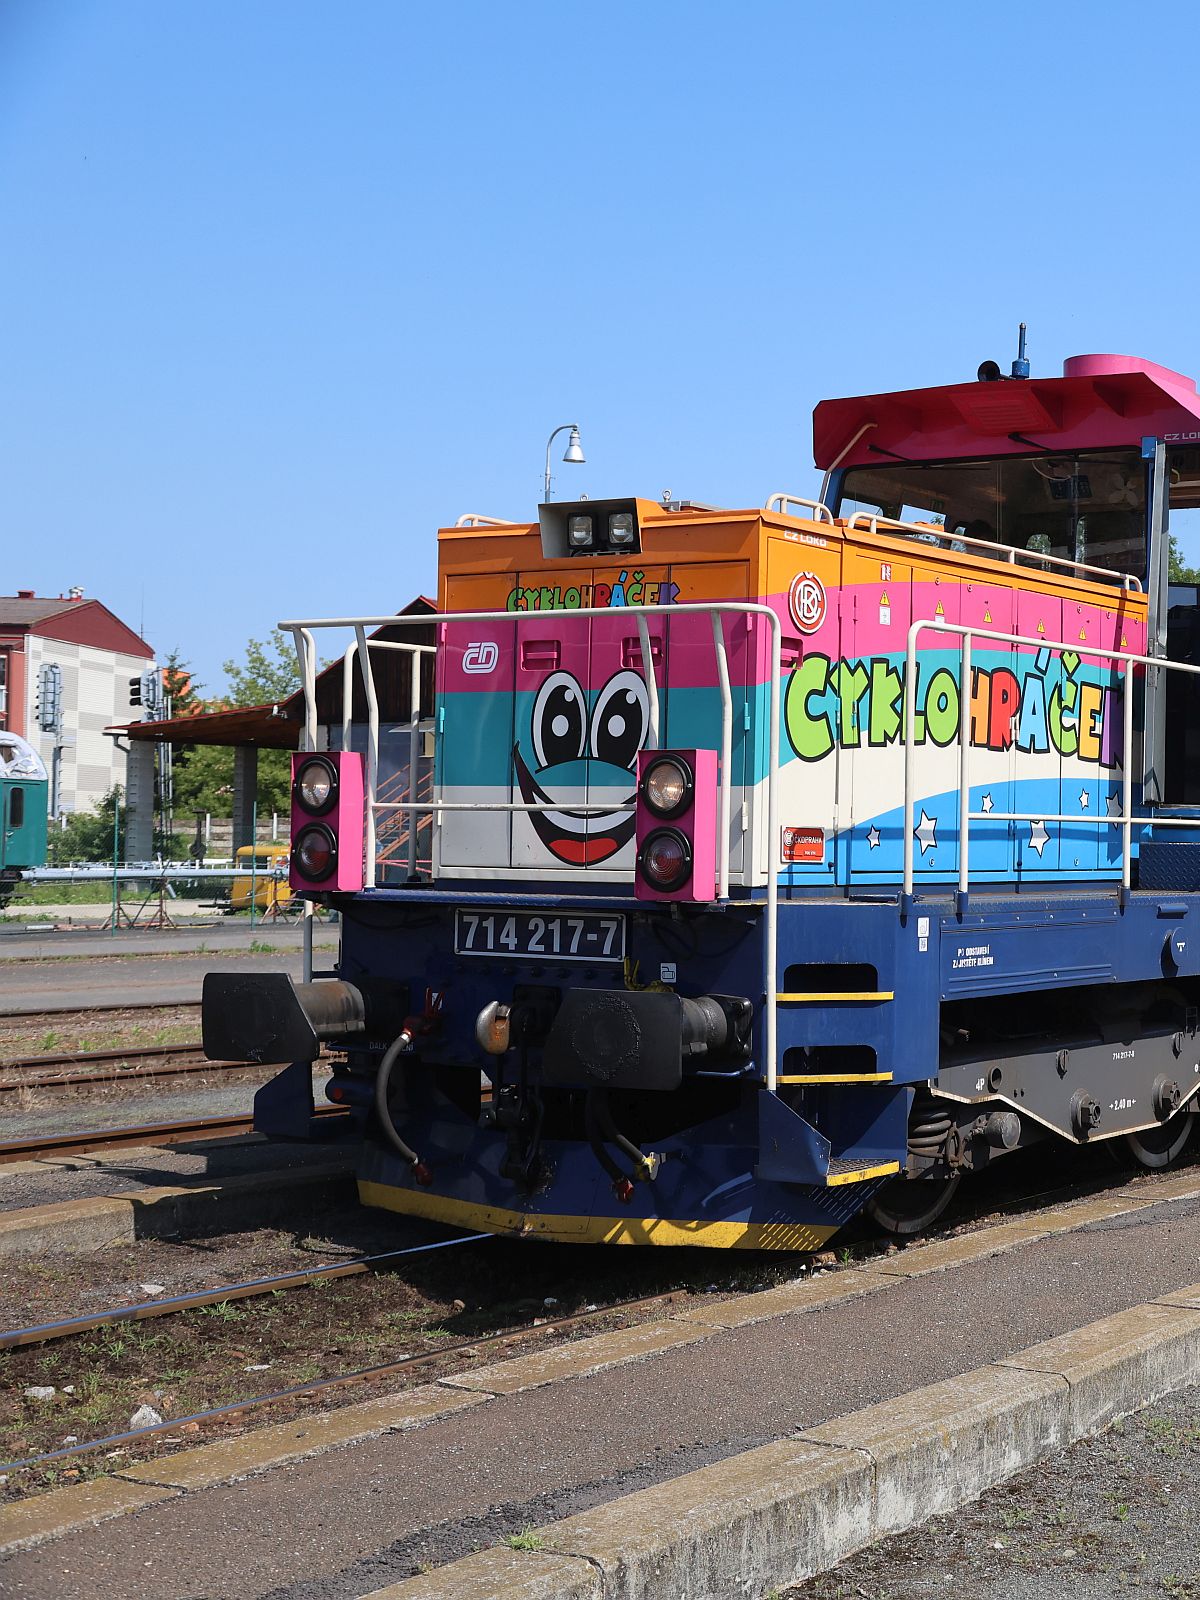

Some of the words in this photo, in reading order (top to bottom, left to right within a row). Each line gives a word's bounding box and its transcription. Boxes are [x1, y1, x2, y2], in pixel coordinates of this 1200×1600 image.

[1164, 433, 1180, 441] CZ
[783, 530, 799, 541] CZ
[800, 535, 827, 547] LOKO
[463, 915, 518, 951] 714
[527, 917, 618, 955] 217-7
